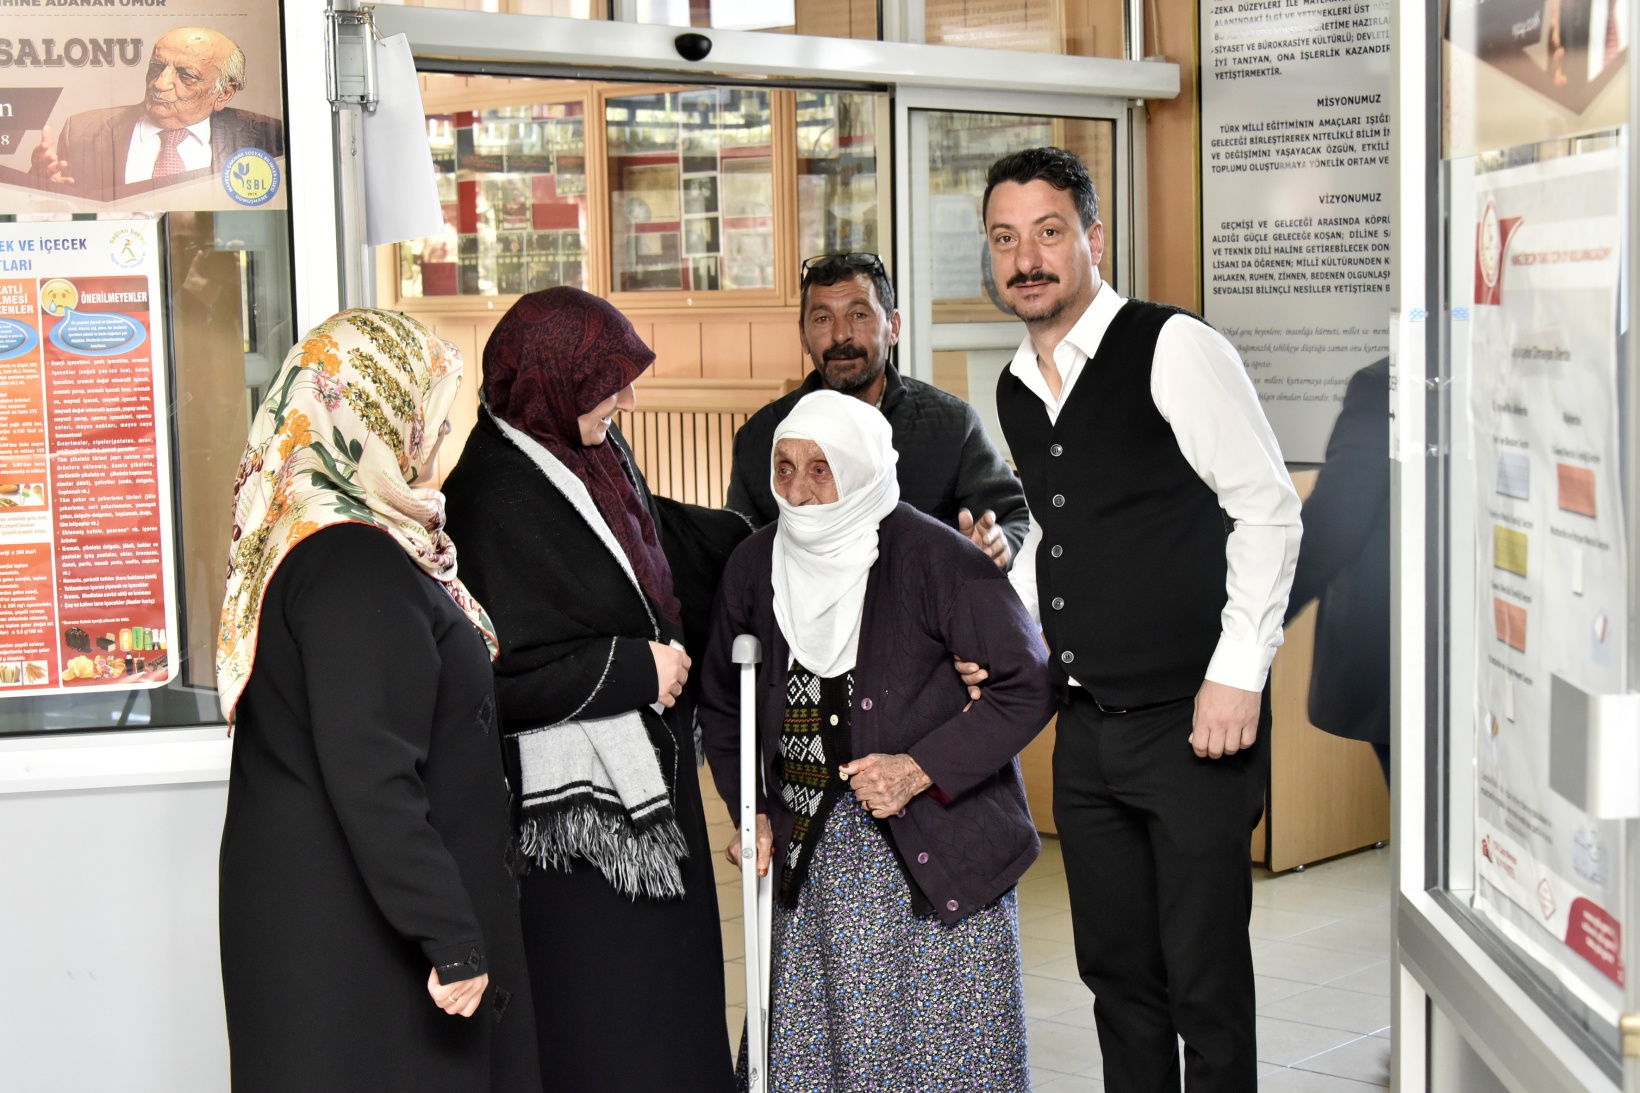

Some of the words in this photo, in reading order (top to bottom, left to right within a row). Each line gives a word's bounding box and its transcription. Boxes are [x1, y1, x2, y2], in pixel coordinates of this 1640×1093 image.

[1215, 6, 1233, 14] ZEKA
[1266, 12, 1282, 22] İLGİ
[1354, 4, 1369, 14] ÜST
[1215, 42, 1244, 53] SİYASET
[1258, 36, 1309, 49] BÜROKRASİYE
[1312, 32, 1354, 44] KÜLTÜRLÜ;
[0, 38, 144, 68] SALONU
[1215, 57, 1227, 67] İYİ
[1233, 55, 1271, 65] TANIYAN,
[1277, 54, 1295, 62] ONA
[1301, 46, 1339, 60] İŞLERLİK
[1215, 67, 1282, 80] YETİŞTİRMEKTİR.
[1317, 94, 1381, 107] MİSYONUMUZ
[1220, 124, 1239, 133] TÜRK
[1242, 122, 1264, 132] MİLLİ
[1319, 117, 1361, 129] AMAÇLARI
[1211, 134, 1247, 147] GELECEĞİ
[1250, 131, 1310, 145] BİRLEŞTİREREK
[1357, 128, 1380, 138] BİLİM
[1275, 146, 1321, 158] YAŞAYACAK
[1326, 144, 1356, 153] ÖZGÜN,
[1362, 142, 1389, 152] ETKİLİ
[1212, 164, 1247, 173] TOPLUMU
[1250, 160, 1306, 171] OLUŞTURMAYA
[1348, 157, 1376, 166] ORTAM
[1378, 156, 1389, 164] VE
[246, 179, 266, 190] SBL
[1319, 193, 1381, 204] VİZYONUMUZ
[1221, 221, 1253, 231] GEÇMİŞİ
[1275, 217, 1312, 228] GELECEĞİ
[1318, 217, 1359, 227] ARASINDA
[1213, 234, 1239, 243] ALDIĞI
[1244, 232, 1268, 243] GÜÇLE
[1273, 231, 1311, 241] GELECEĞE
[1314, 231, 1344, 241] KOŞAN;
[1350, 229, 1378, 239] DİLİNE
[19, 240, 34, 251] VE
[40, 237, 87, 254] İÇECEK
[1225, 246, 1252, 255] TEKNİK
[1255, 244, 1271, 255] DİLİ
[1274, 244, 1303, 254] HALİNE
[1306, 241, 1368, 253] GETİREBİLECEK
[1213, 259, 1239, 269] LİSANI
[1241, 260, 1251, 268] DA
[1254, 257, 1293, 268] ÖĞRENEN;
[1213, 273, 1247, 282] AHLAKEN,
[1250, 272, 1275, 281] RUHEN,
[1278, 270, 1308, 281] ZİHNEN,
[1311, 271, 1345, 280] BEDENEN
[1213, 286, 1253, 295] SEVDALISI
[1256, 284, 1290, 295] BİLİNÇLİ
[1293, 283, 1331, 293] NESİLLER
[1334, 282, 1382, 294] YETİŞTİREN
[81, 291, 147, 304] ÖNERİLMEYENLER
